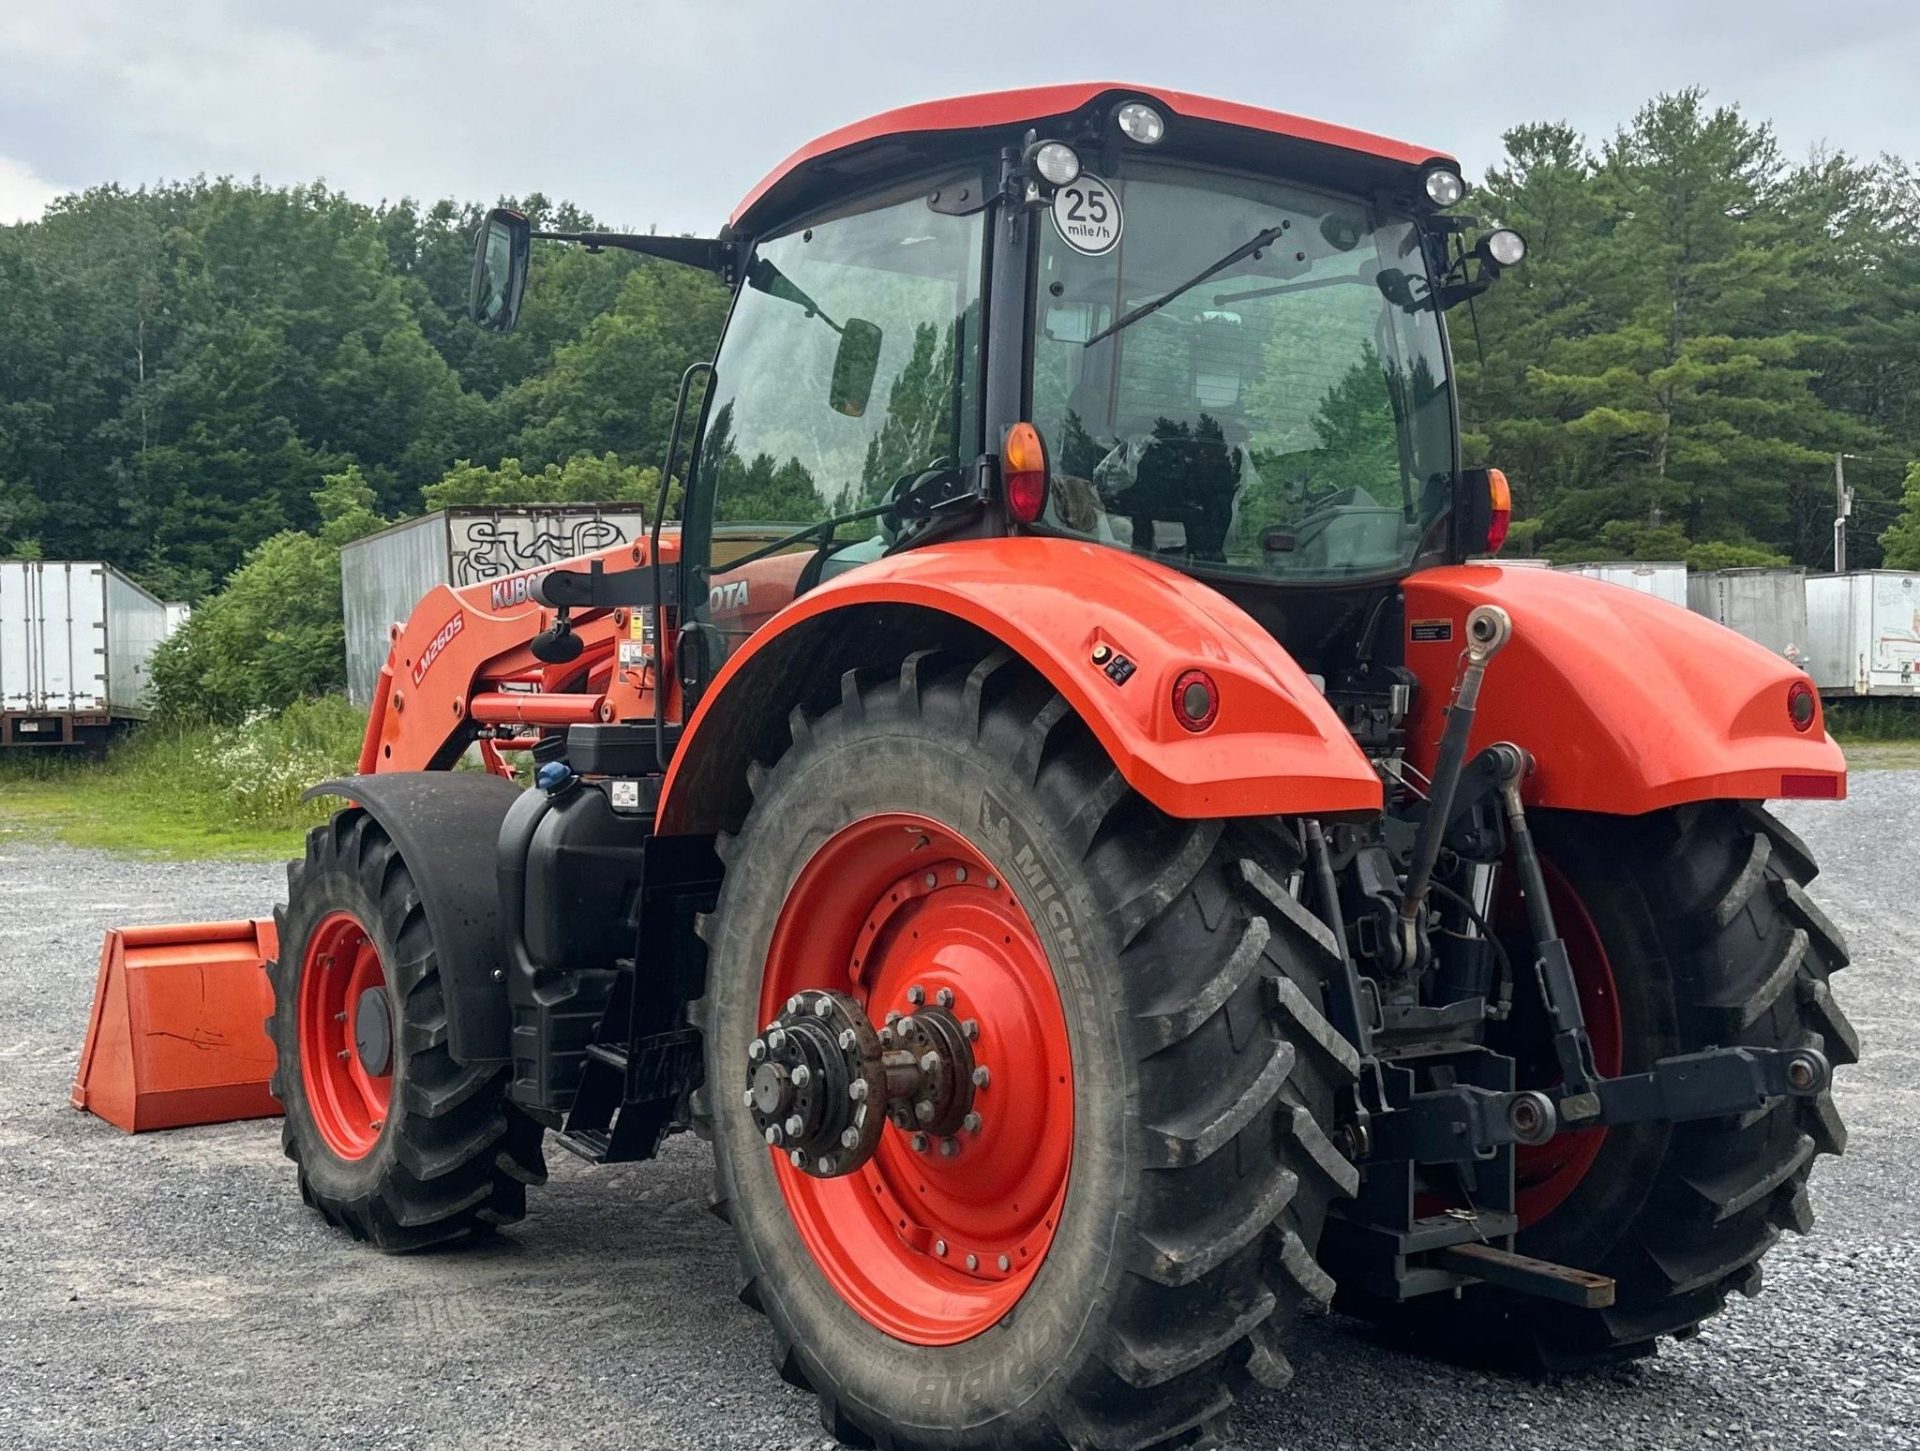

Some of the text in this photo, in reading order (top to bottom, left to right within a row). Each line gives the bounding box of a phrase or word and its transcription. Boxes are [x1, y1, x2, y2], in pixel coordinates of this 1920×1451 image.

[1064, 188, 1108, 224] 25
[1068, 223, 1110, 238] mile/h
[491, 568, 556, 611] KUBO
[709, 580, 749, 614] OTA
[413, 613, 463, 685] LM2605
